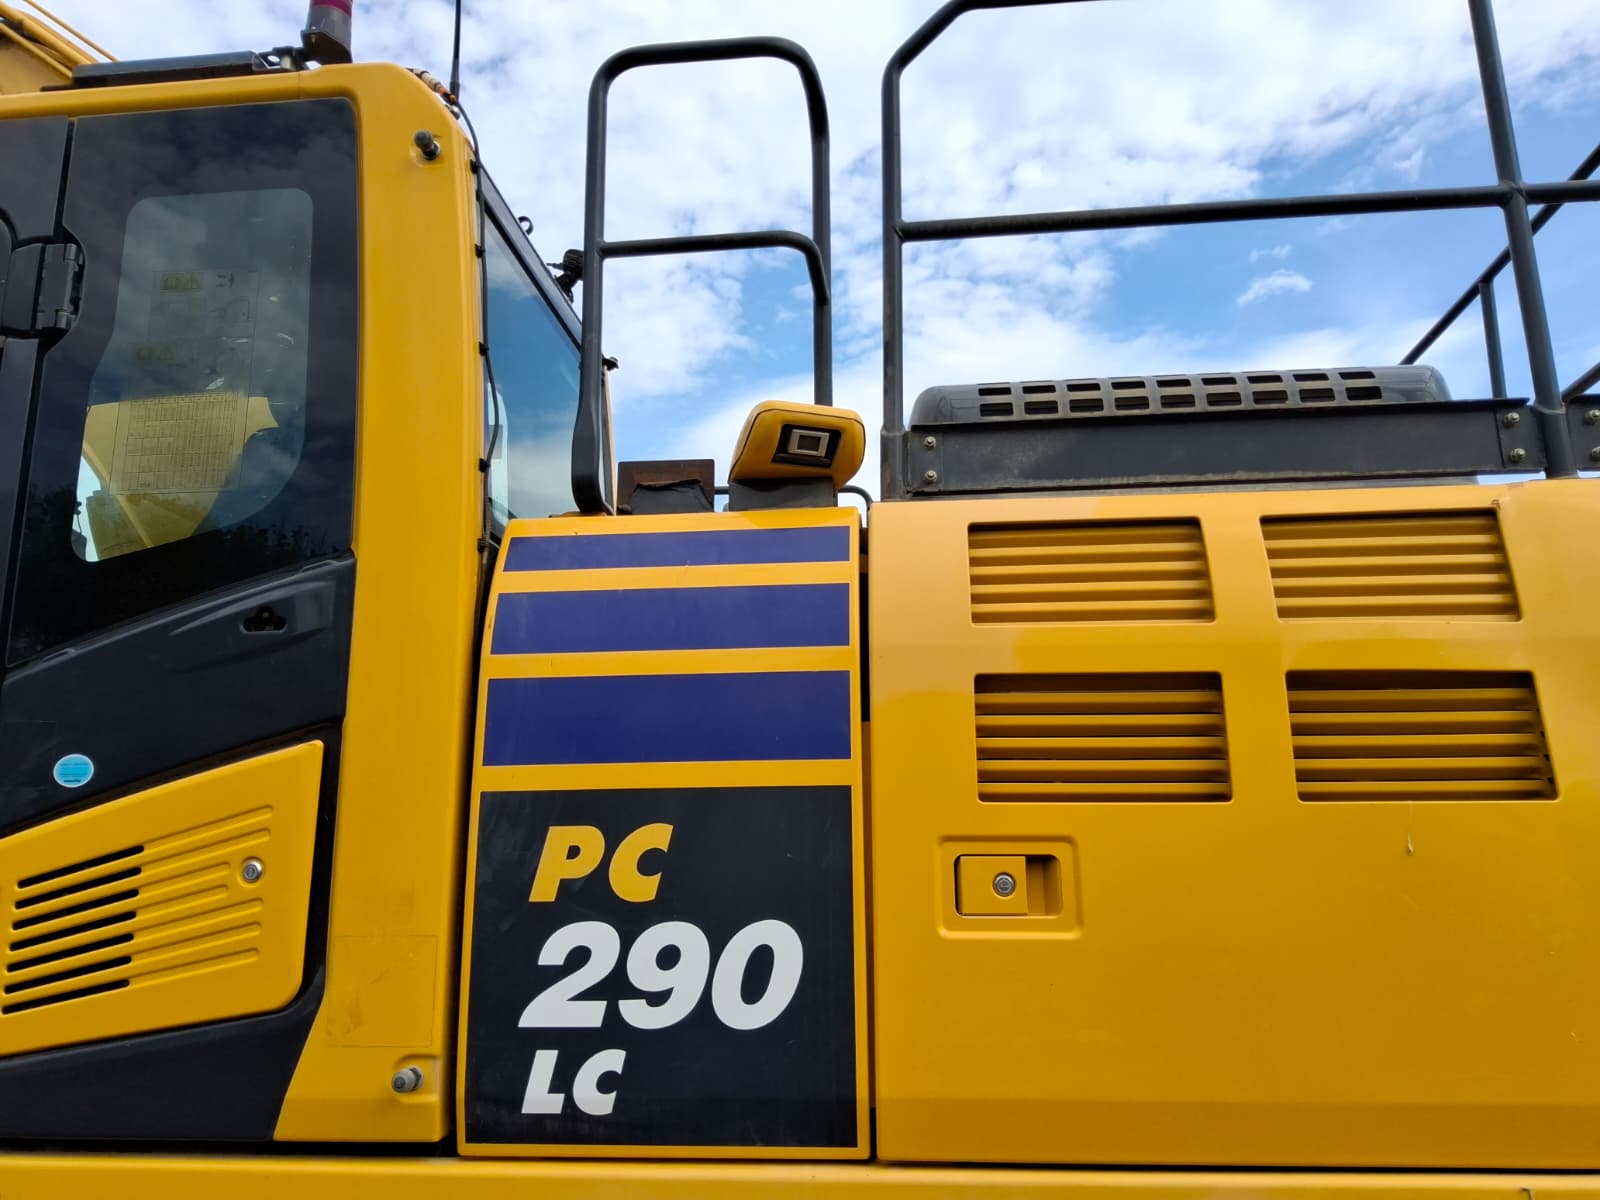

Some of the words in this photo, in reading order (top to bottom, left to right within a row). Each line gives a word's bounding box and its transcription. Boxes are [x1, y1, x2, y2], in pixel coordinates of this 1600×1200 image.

[528, 823, 674, 903] PC
[517, 920, 804, 1030] 290
[521, 1048, 627, 1116] LC
